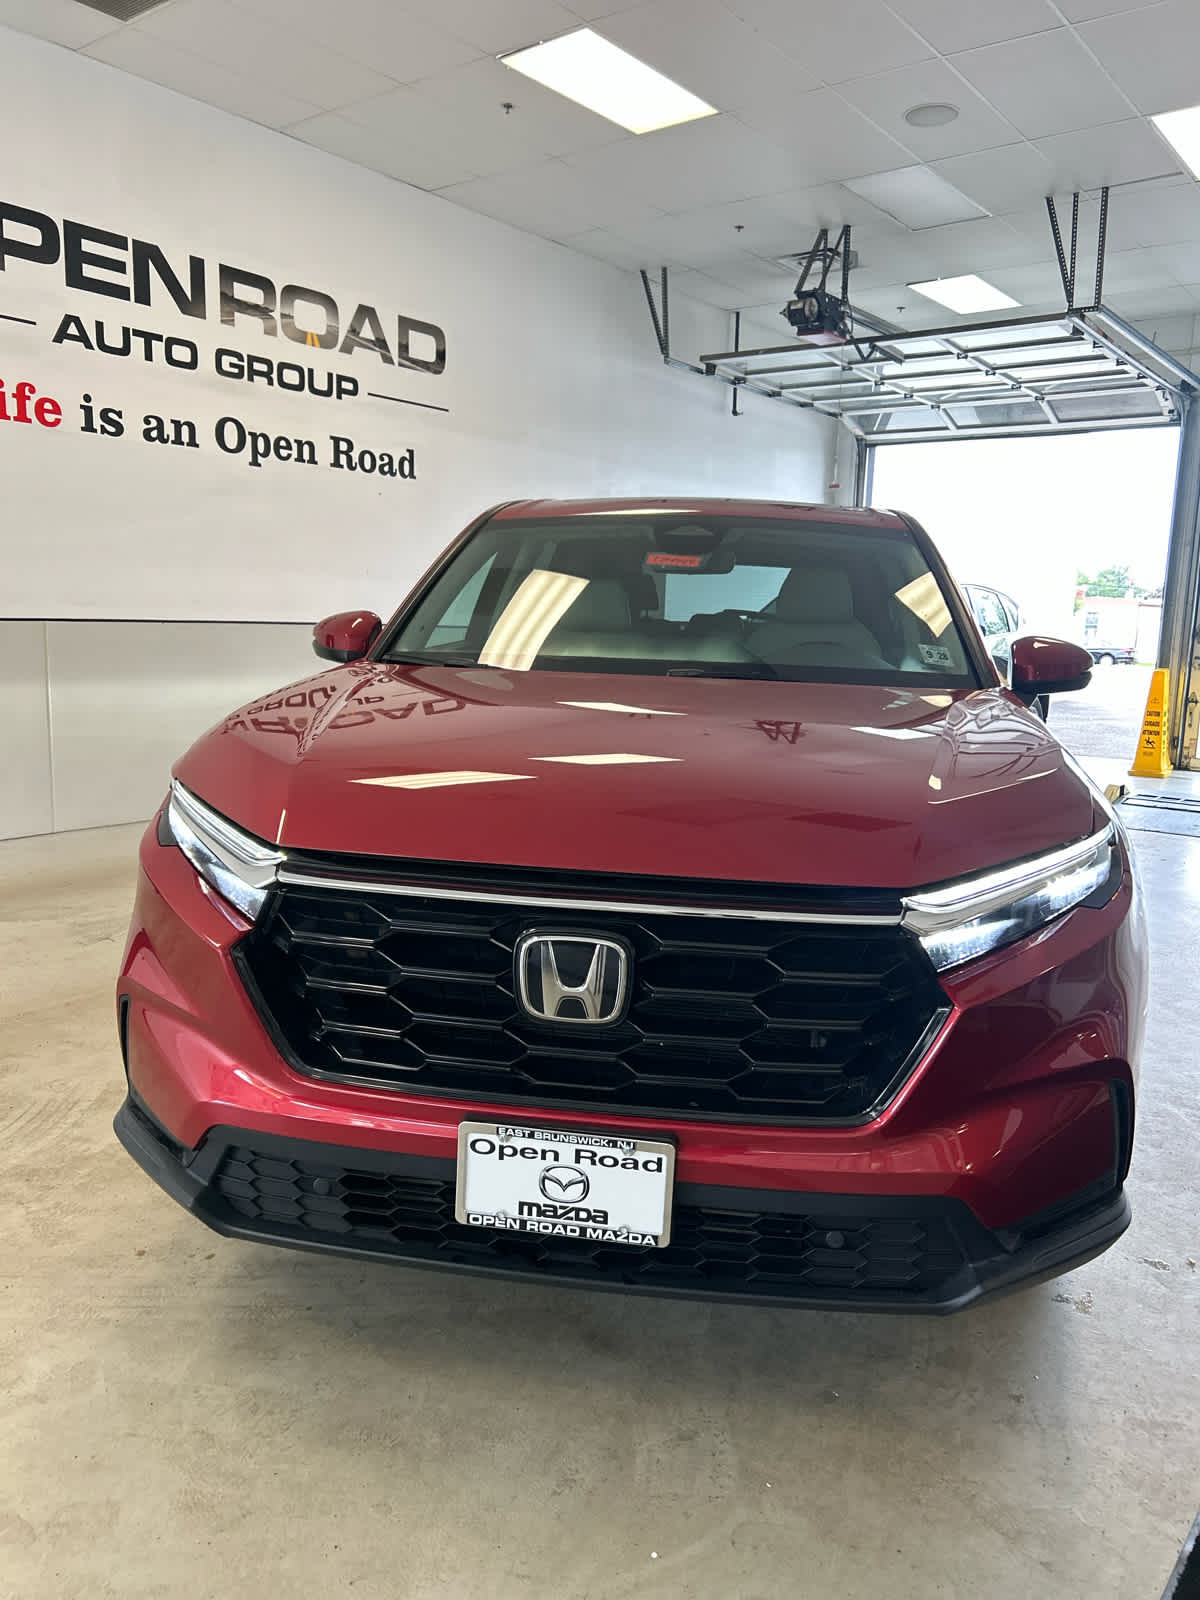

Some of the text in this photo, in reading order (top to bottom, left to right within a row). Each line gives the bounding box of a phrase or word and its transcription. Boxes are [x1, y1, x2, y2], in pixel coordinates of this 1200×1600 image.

[218, 263, 447, 375] ROAD
[52, 313, 359, 400] AUTO GROUP
[79, 394, 125, 437] is
[142, 413, 200, 448] an
[214, 416, 318, 467] Open
[329, 435, 417, 480] Road
[469, 1138, 663, 1173] Open Road
[498, 1127, 531, 1138] EAST
[616, 1140, 635, 1150] NJ
[469, 1213, 656, 1246] OPEN ROAD MAZDA
